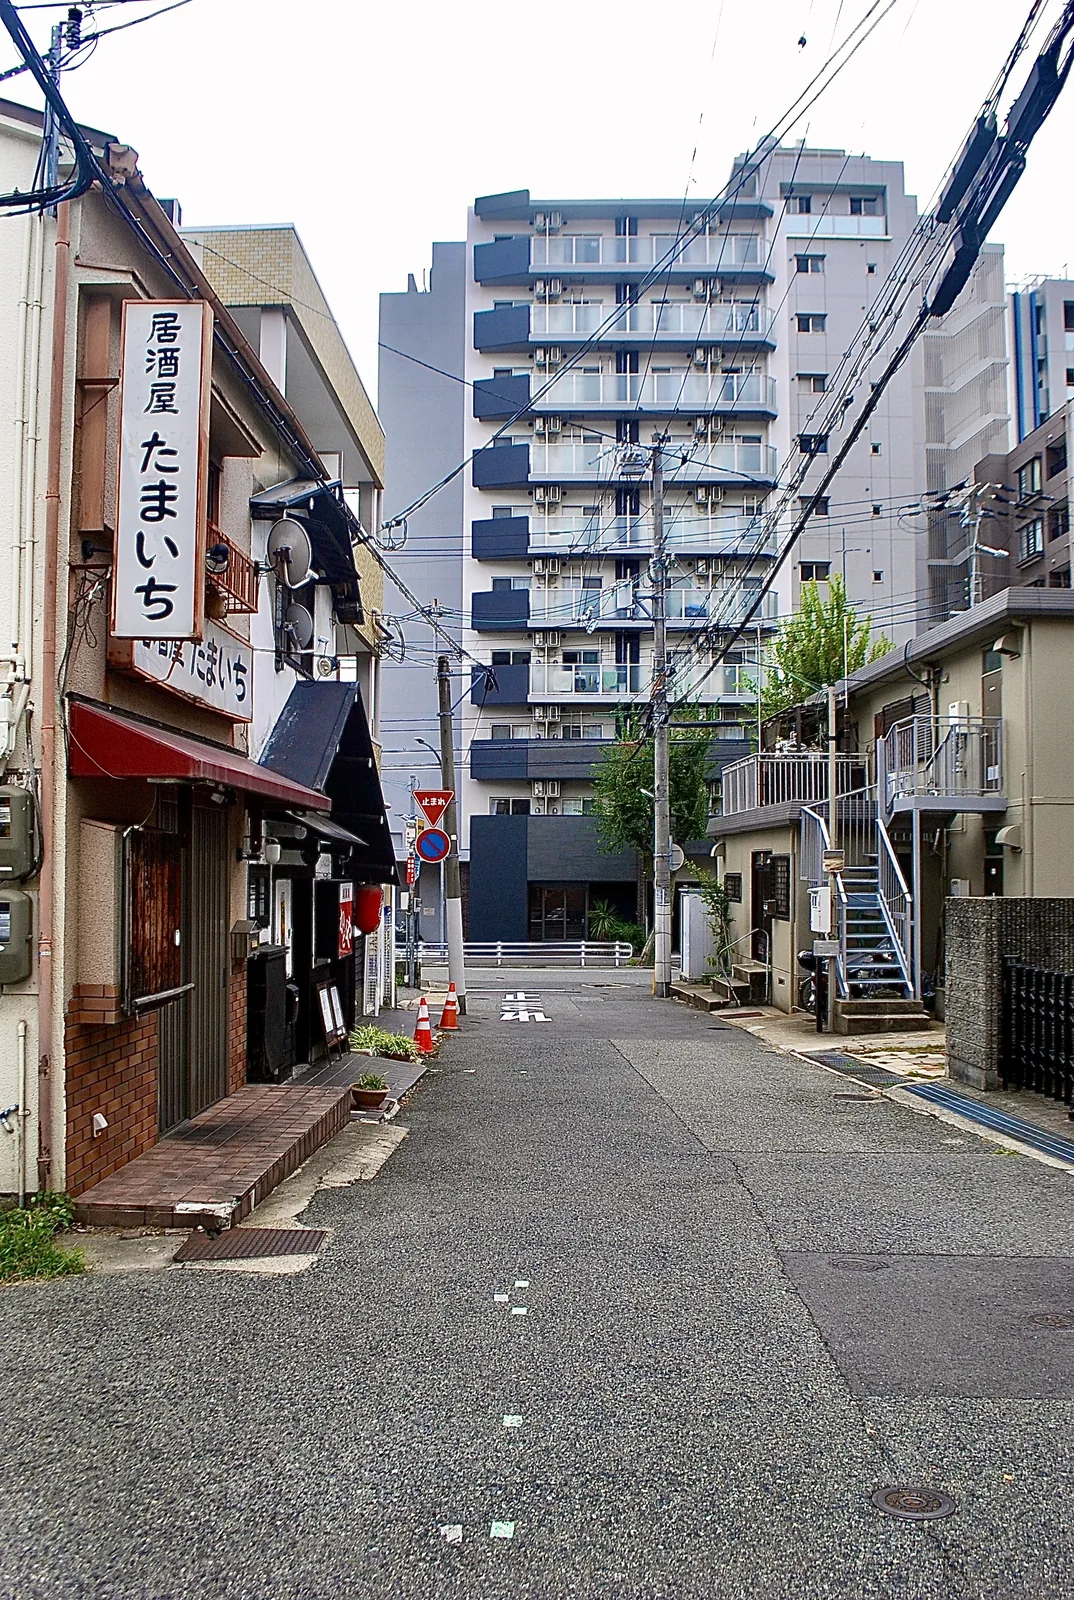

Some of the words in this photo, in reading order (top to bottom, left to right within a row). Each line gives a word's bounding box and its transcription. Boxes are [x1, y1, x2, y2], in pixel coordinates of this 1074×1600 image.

[145, 313, 181, 414] 居酒屋
[134, 431, 179, 620] たまいち
[190, 637, 247, 702] たまいち
[421, 797, 446, 806] 止まれ
[499, 992, 553, 1022] 止まれ
